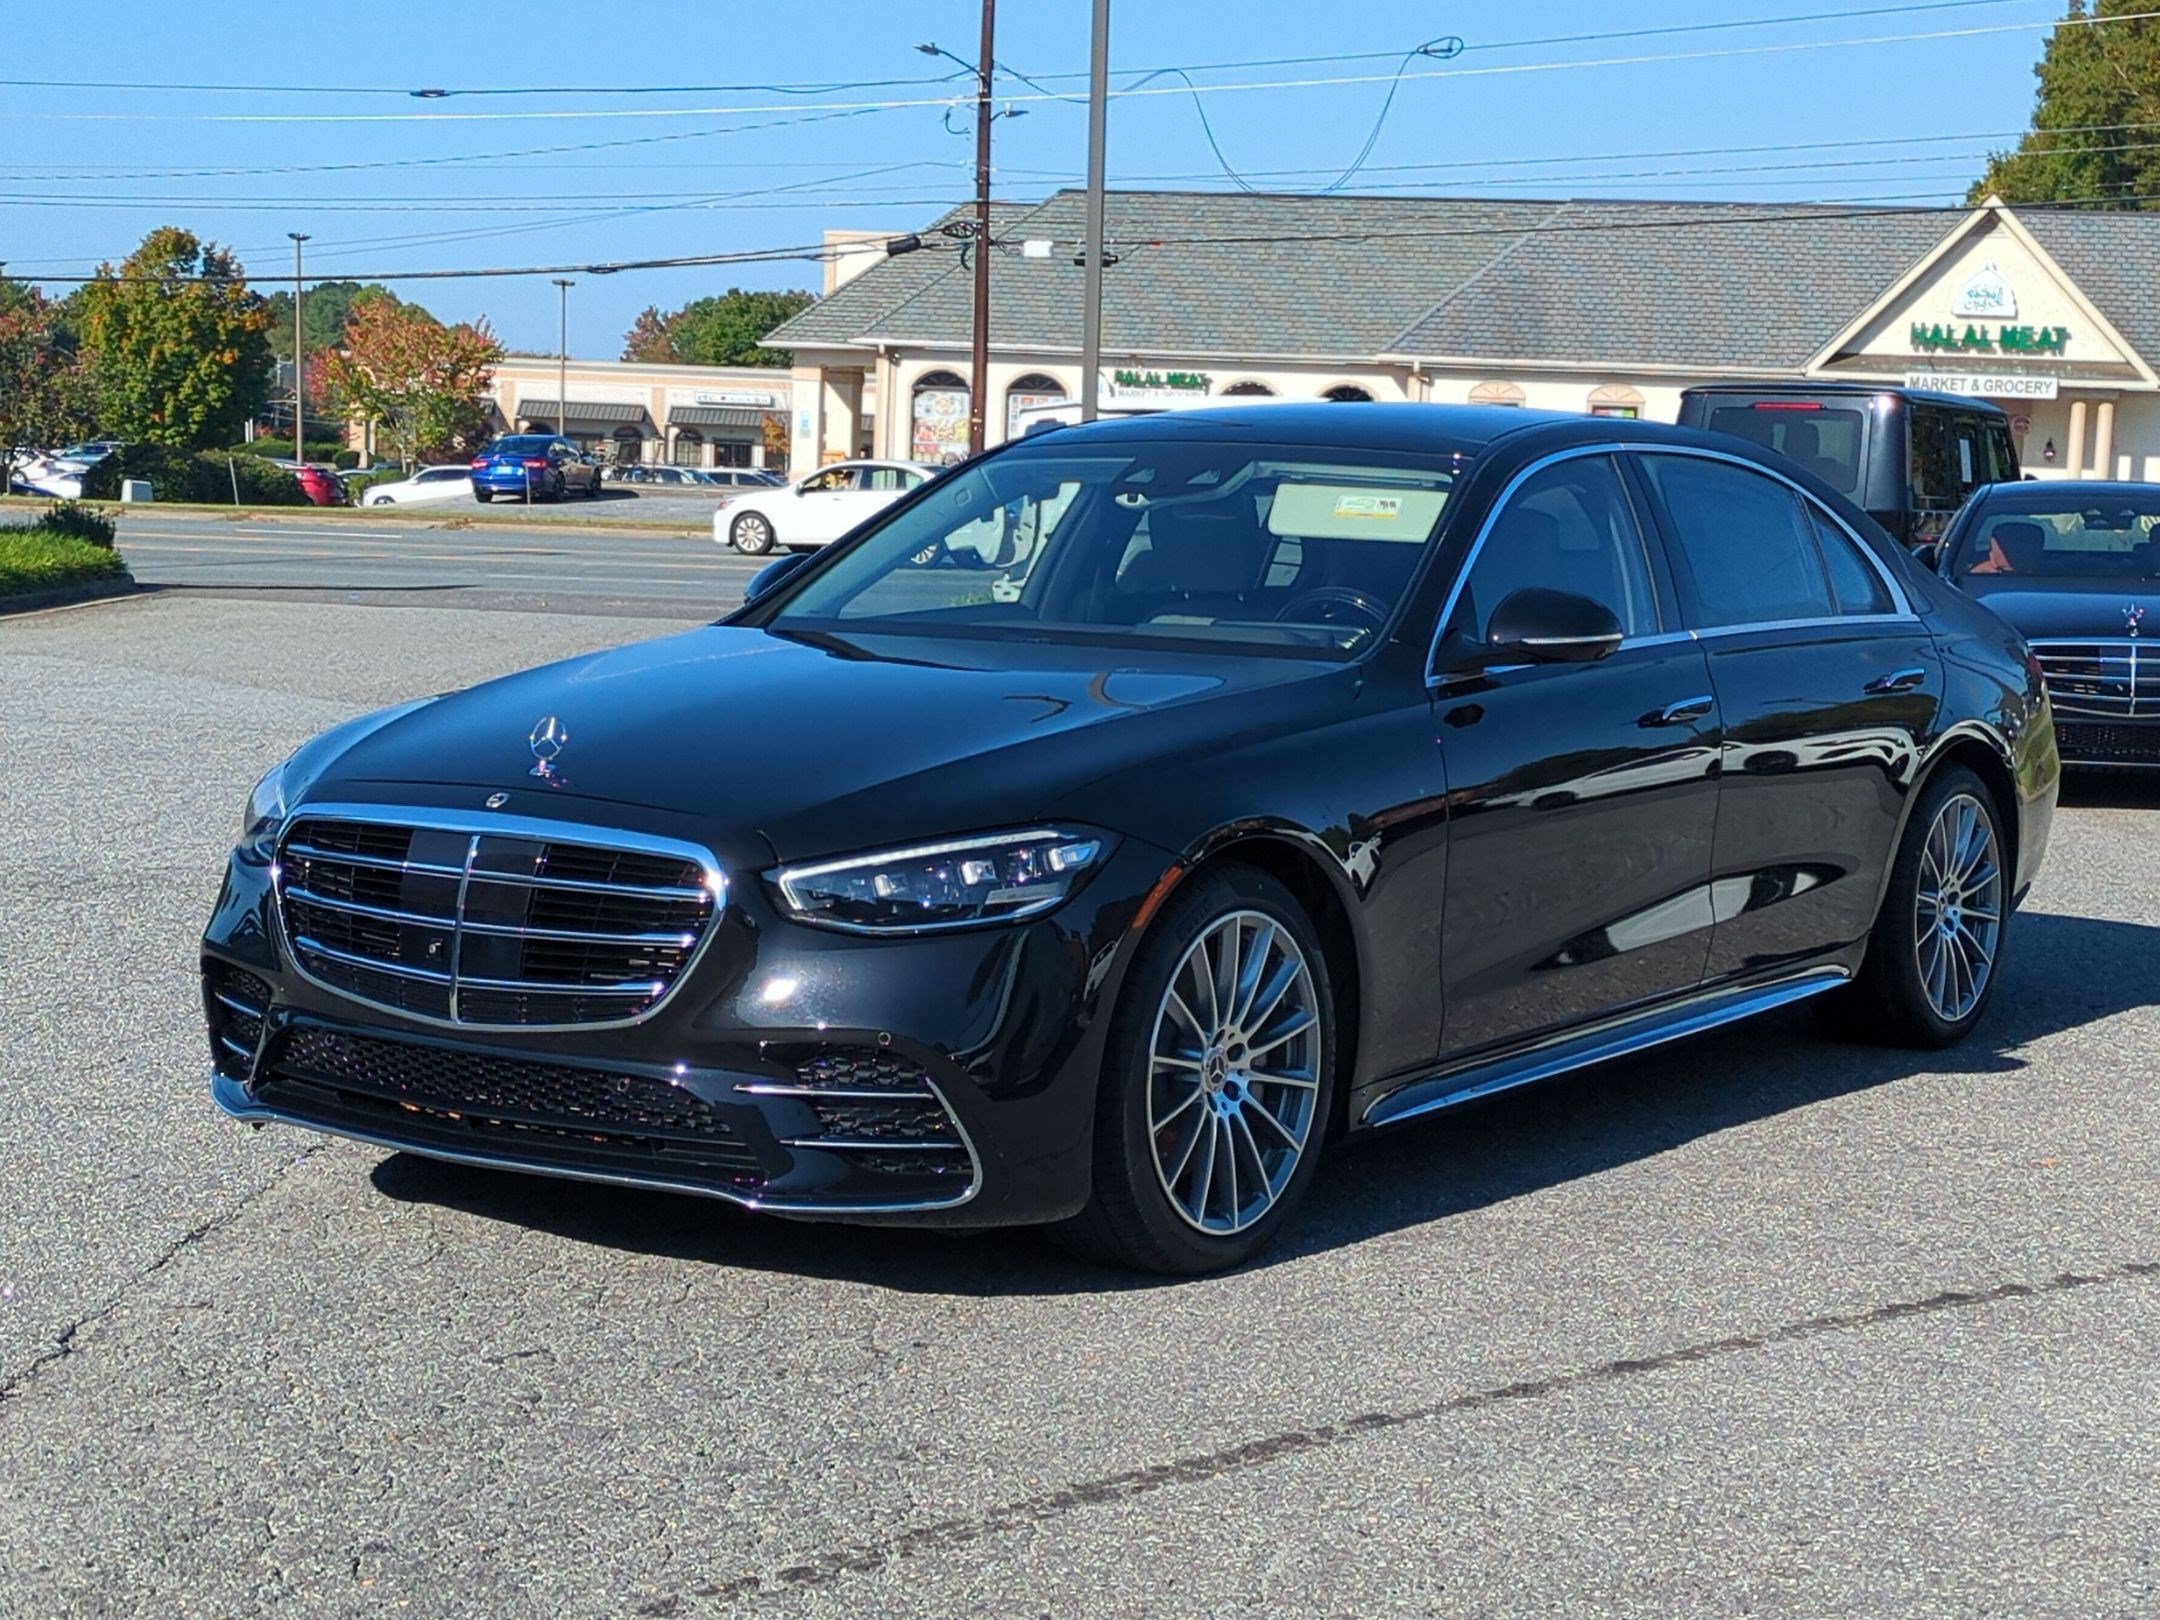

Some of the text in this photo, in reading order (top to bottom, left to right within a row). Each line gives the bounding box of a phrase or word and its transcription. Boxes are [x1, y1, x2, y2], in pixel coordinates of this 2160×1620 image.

[1911, 322, 2067, 353] HALAL MEAT
[1166, 372, 1207, 389] MEAT
[1909, 376, 2052, 395] MARKET & GROCERY
